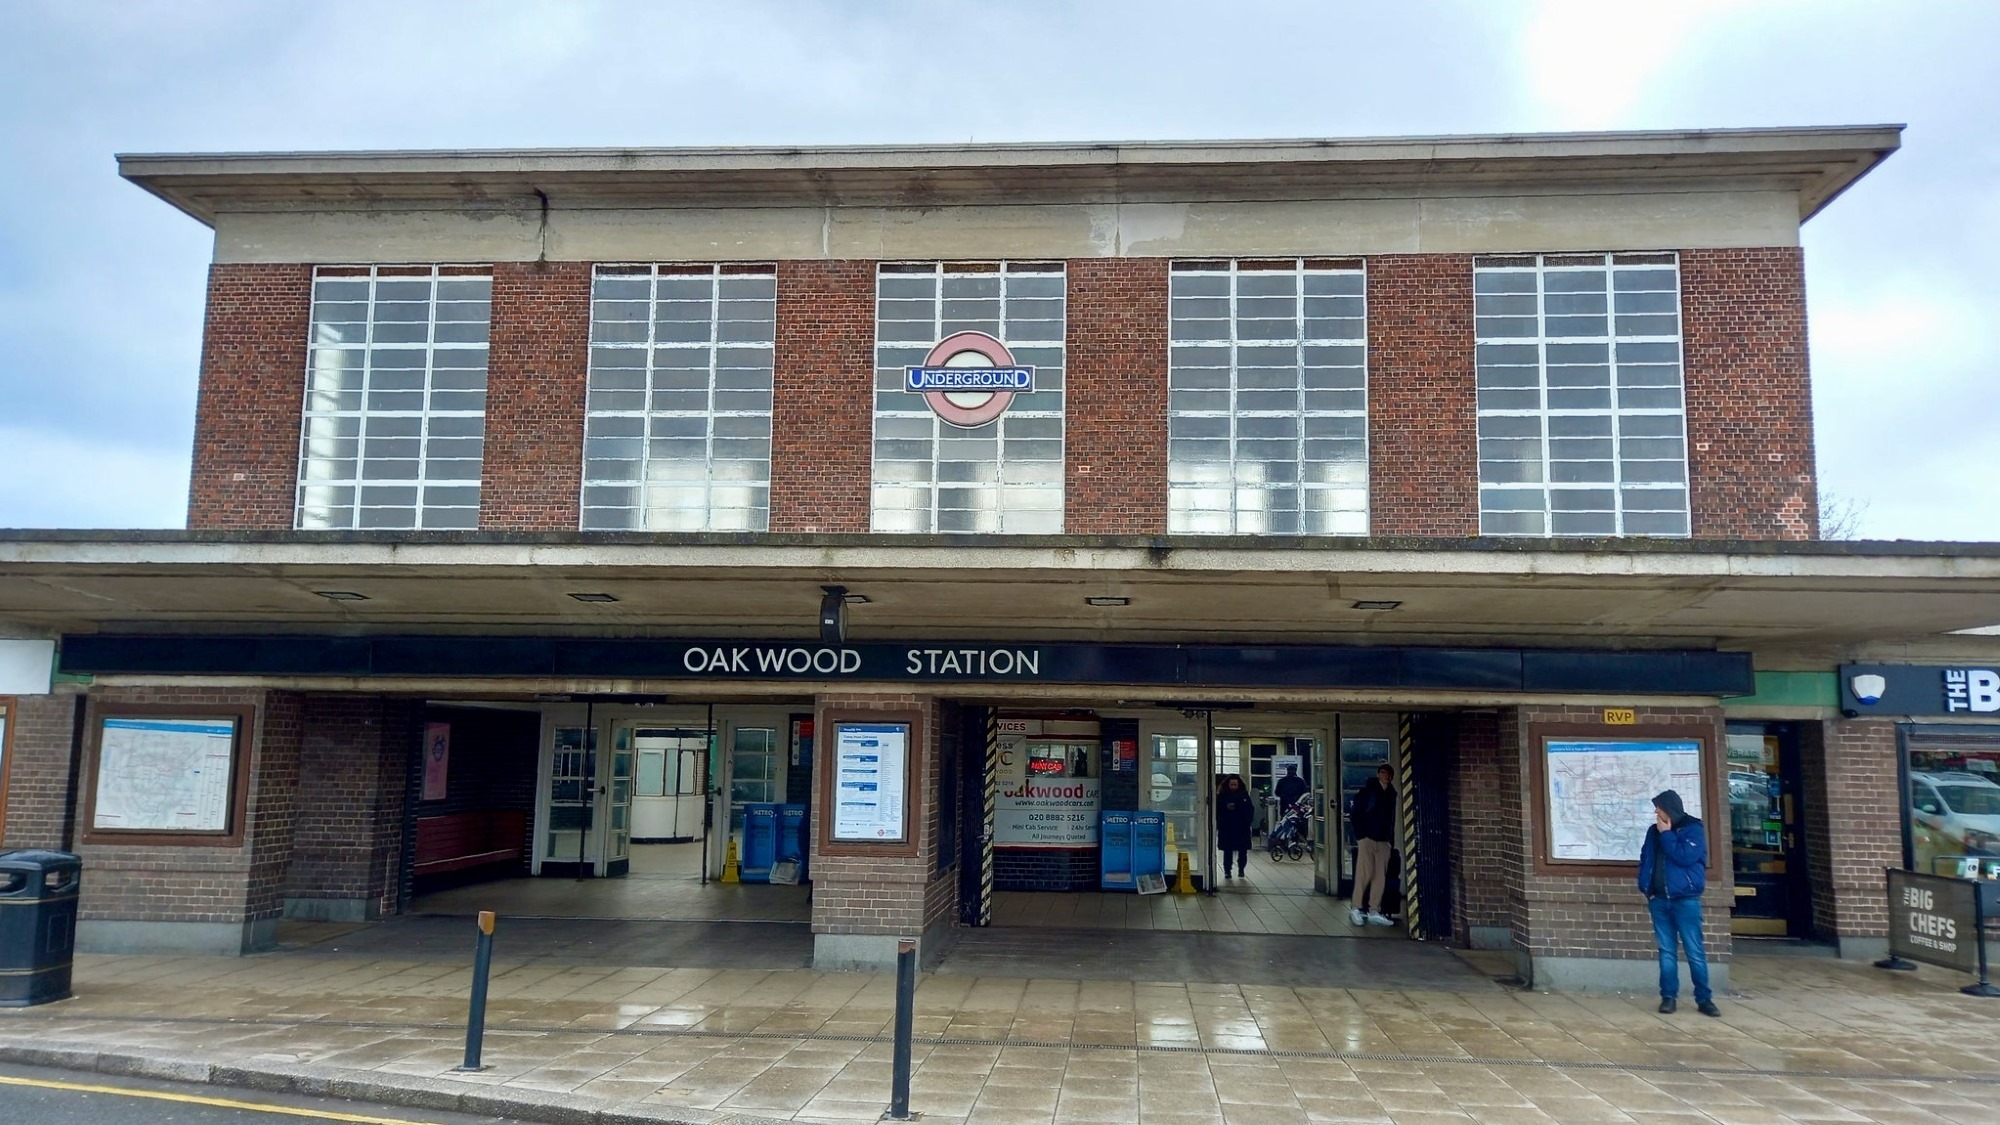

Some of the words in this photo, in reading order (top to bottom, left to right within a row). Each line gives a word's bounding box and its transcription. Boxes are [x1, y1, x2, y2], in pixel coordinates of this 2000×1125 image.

[908, 369, 1030, 388] UNDERGROUND
[906, 649, 1040, 675] STATION
[1946, 669, 1968, 712] THE
[1968, 670, 2000, 712] B
[1607, 711, 1632, 722] RVP
[1004, 781, 1084, 798] oakwood
[783, 809, 804, 817] METRO
[1028, 813, 1044, 821] 020
[1067, 814, 1086, 822] 5216
[1106, 815, 1128, 824] METRO
[1138, 817, 1159, 825] METRO
[1040, 833, 1065, 841] Journeys
[1910, 887, 1934, 911] BIG
[1910, 911, 1957, 940] CHEFS
[1910, 934, 1933, 948] COFFEE
[1933, 940, 1939, 949] &
[1939, 941, 1957, 953] SHOP
